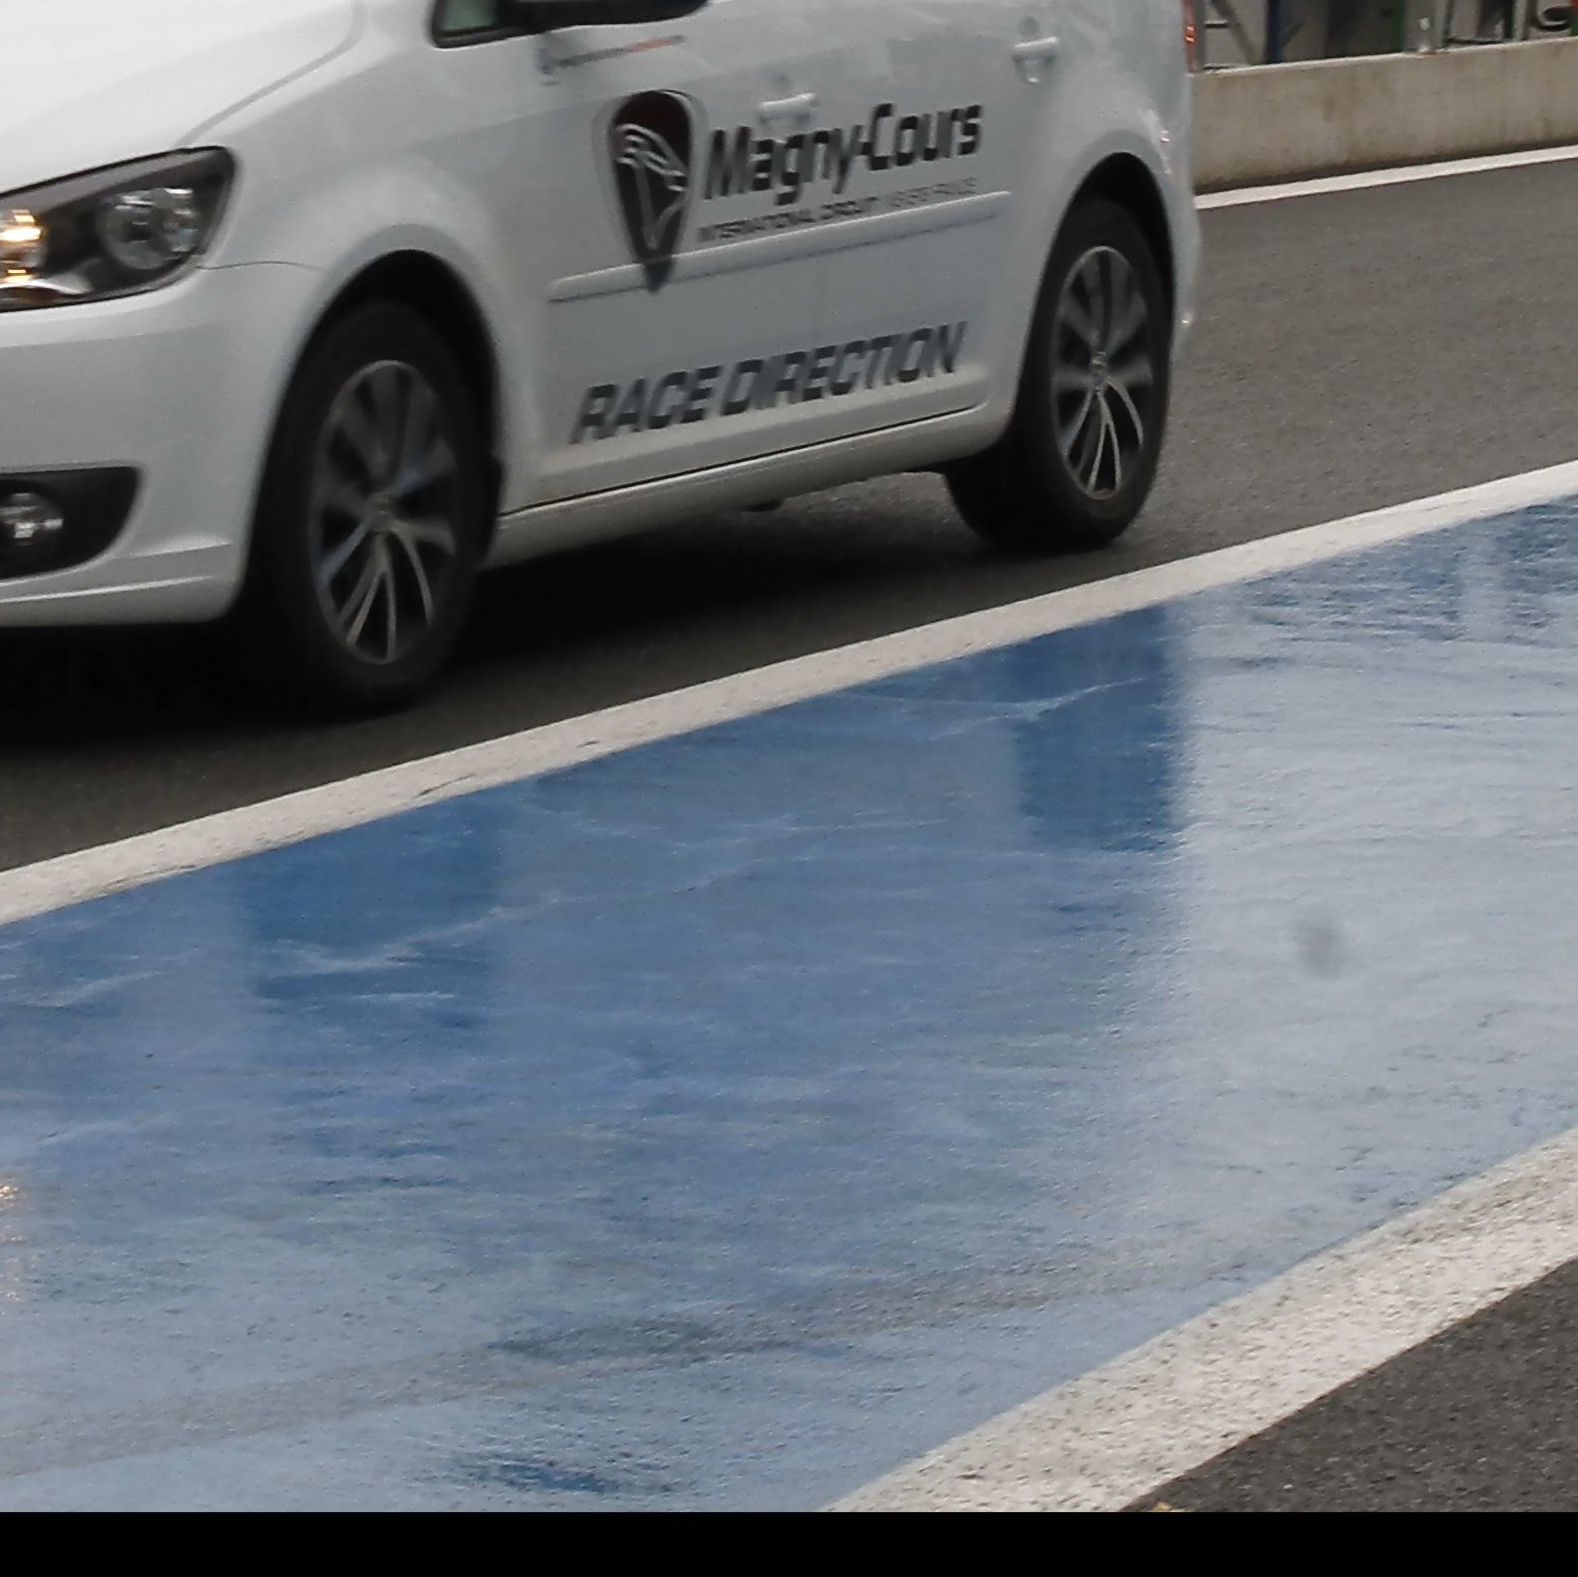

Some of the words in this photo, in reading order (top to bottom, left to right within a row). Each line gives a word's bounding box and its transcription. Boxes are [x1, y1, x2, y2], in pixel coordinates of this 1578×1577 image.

[704, 101, 984, 206] Magny-Cours
[569, 365, 723, 444] RACE
[720, 321, 969, 417] DIRECTION
